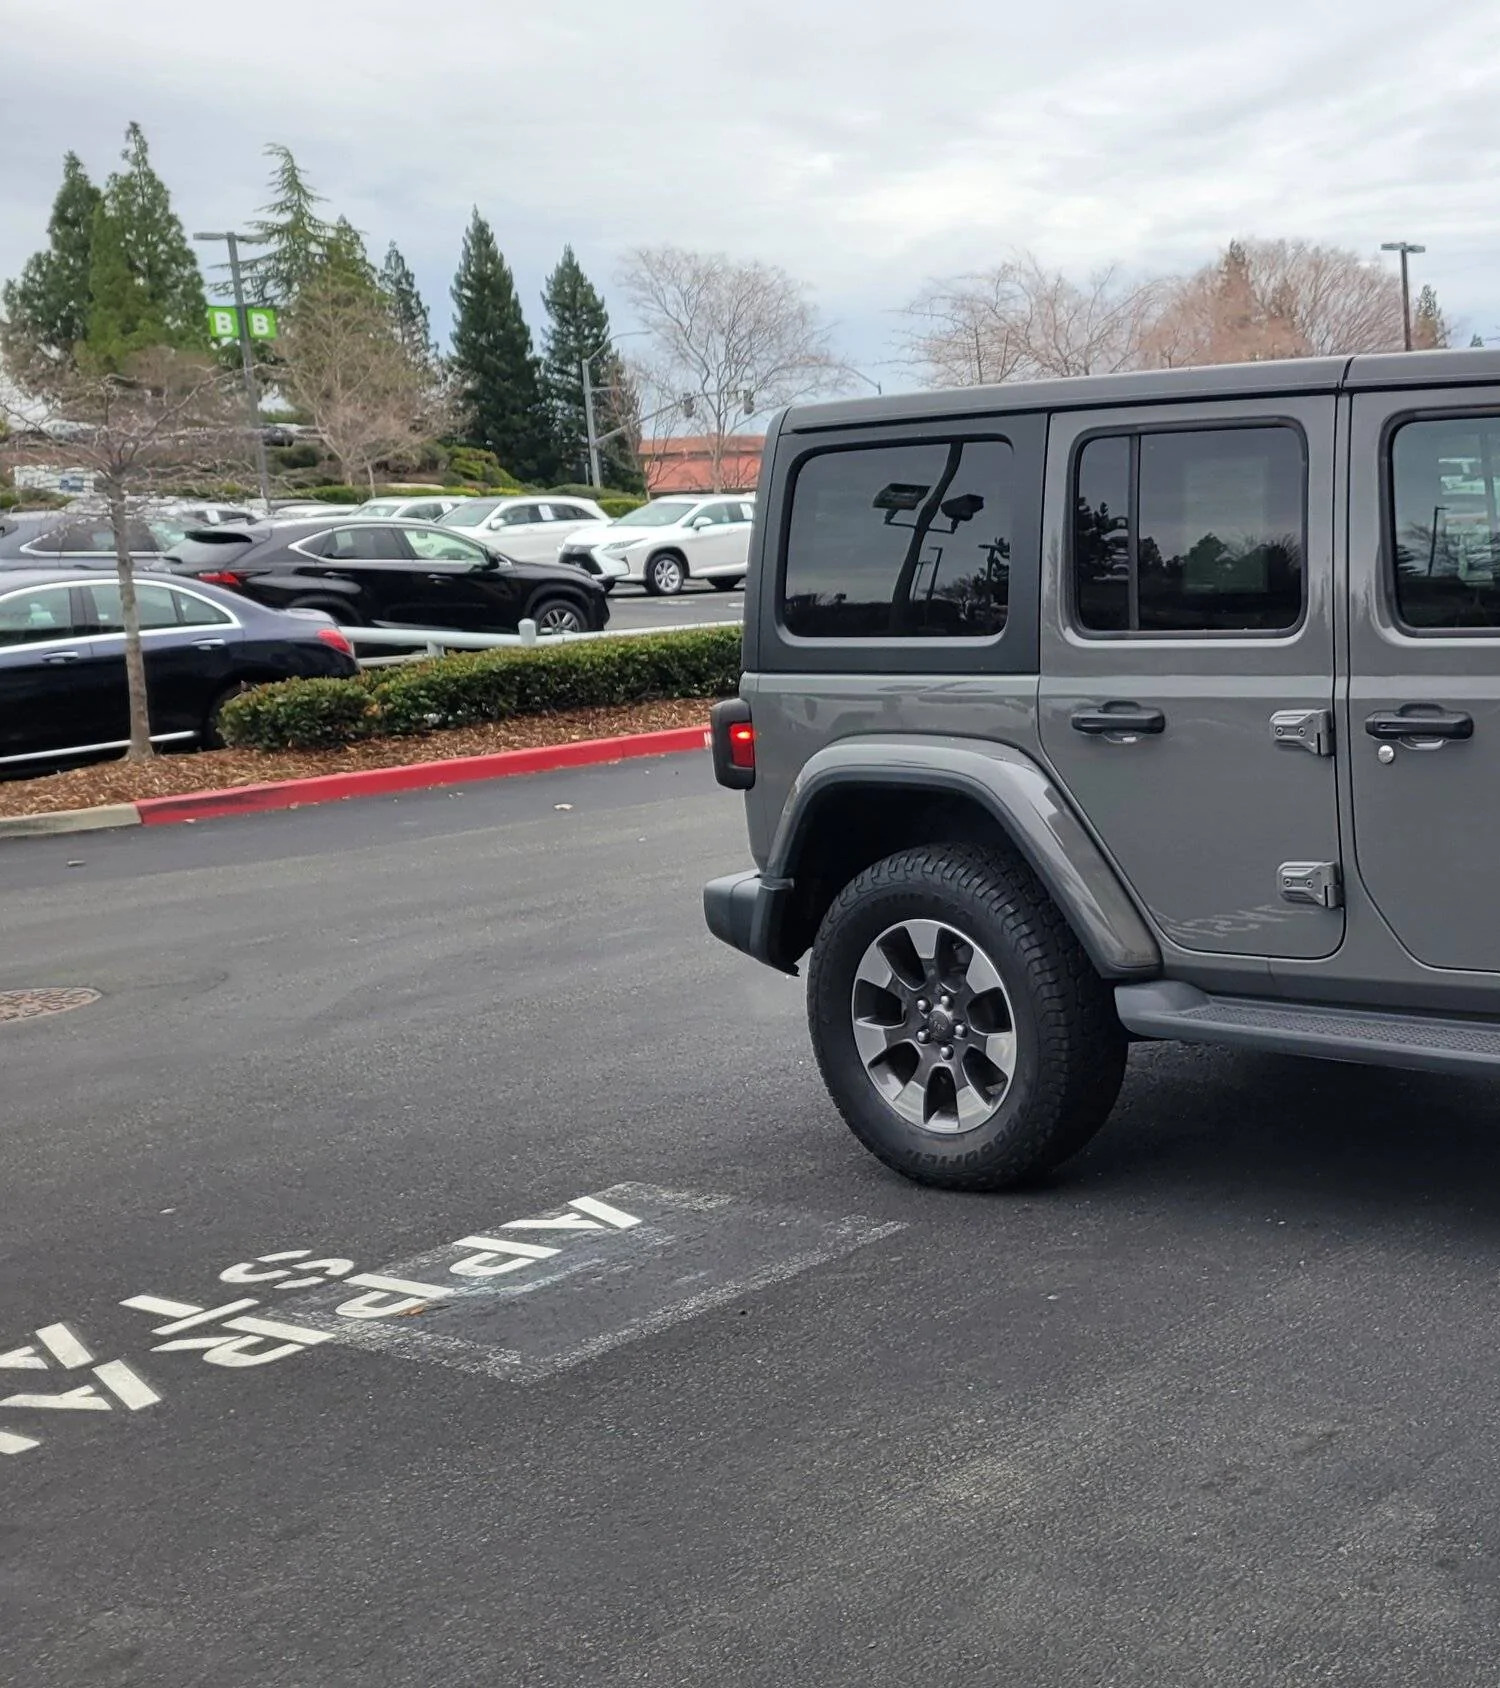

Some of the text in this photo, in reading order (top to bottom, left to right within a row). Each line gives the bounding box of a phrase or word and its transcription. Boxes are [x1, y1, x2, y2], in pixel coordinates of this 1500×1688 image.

[214, 311, 233, 335] B
[252, 312, 269, 335] B
[0, 1196, 642, 1454] APPRA
